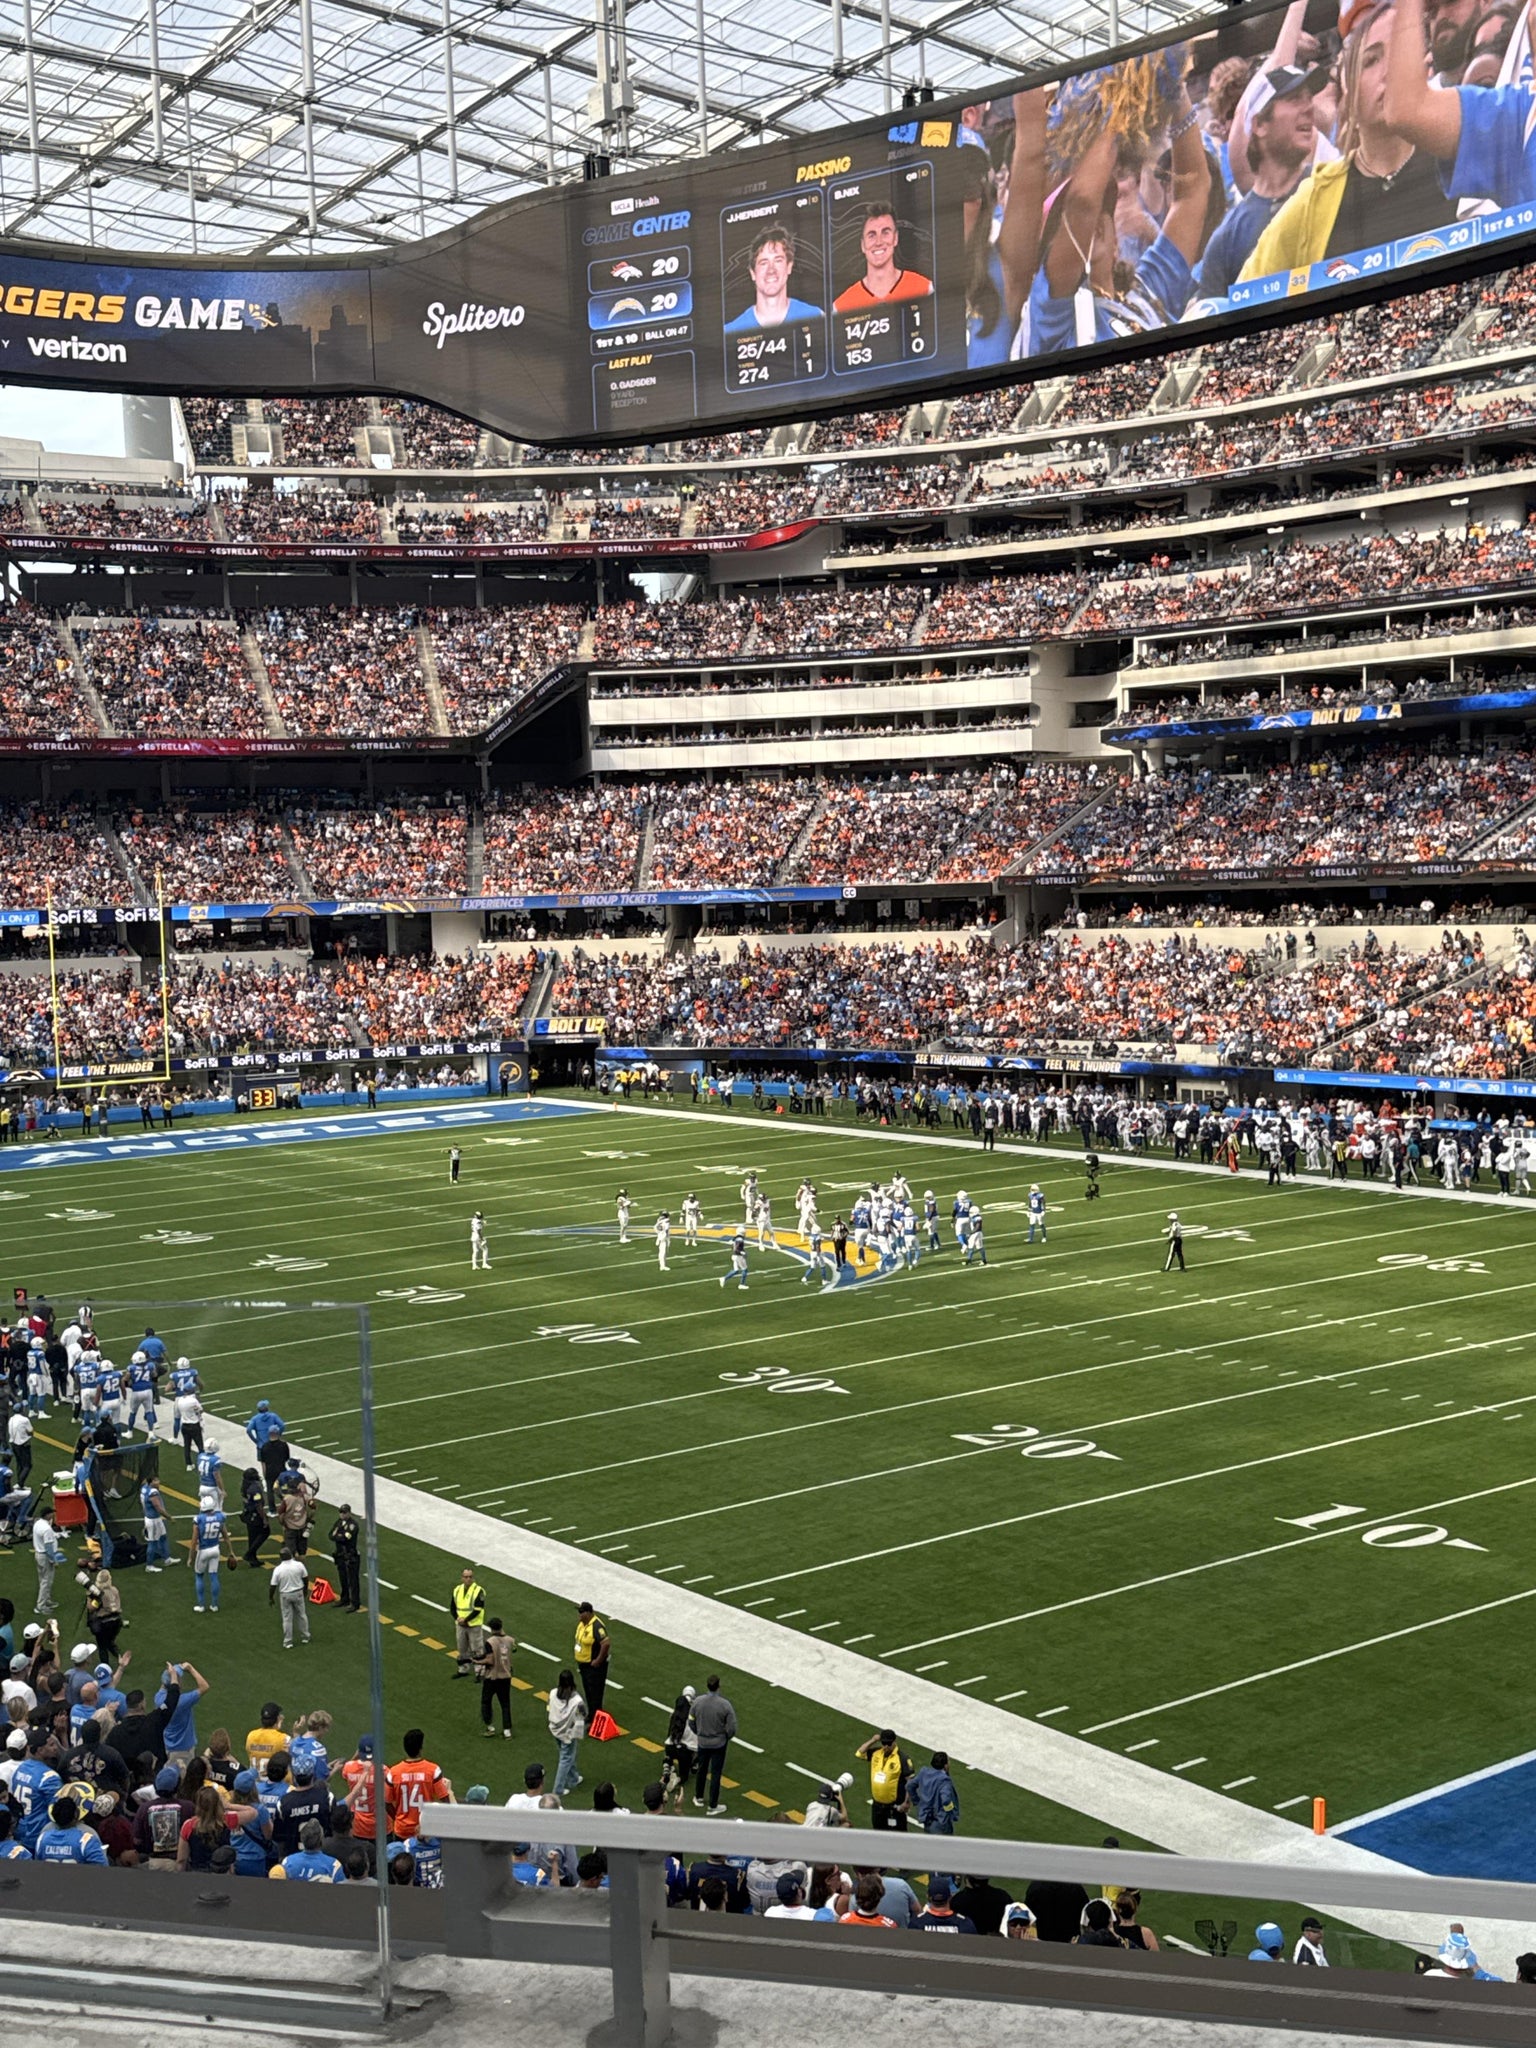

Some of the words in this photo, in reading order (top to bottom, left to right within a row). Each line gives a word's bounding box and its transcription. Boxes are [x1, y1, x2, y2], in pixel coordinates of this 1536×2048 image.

[795, 156, 852, 183] PASSING
[834, 186, 860, 200] B.NIX
[634, 195, 660, 209] Health
[726, 204, 780, 224] J.HERBERT
[581, 221, 632, 246] GAME
[632, 210, 691, 237] CENTER
[1482, 219, 1504, 236] 1ST
[1503, 215, 1516, 228] &
[1517, 209, 1534, 224] 10
[1448, 228, 1469, 246] 20
[651, 256, 680, 277] 20
[1362, 253, 1383, 270] 20
[1291, 274, 1307, 287] 33
[1231, 289, 1251, 303] Q4
[1262, 280, 1281, 295] 1:10
[0, 285, 127, 324] GERS
[134, 296, 246, 331] GAME
[650, 292, 678, 313] 20
[422, 301, 526, 350] Splitero
[913, 311, 921, 327] 1
[644, 329, 665, 340] BALL
[665, 328, 677, 337] ON
[677, 325, 688, 335] 47
[845, 317, 891, 341] 14/25
[596, 338, 614, 349] 1ST
[614, 335, 624, 346] &
[625, 333, 639, 345] 10
[804, 332, 812, 348] 1
[911, 337, 925, 354] 0
[27, 335, 128, 363] verizon
[737, 338, 788, 360] 25/44
[845, 348, 873, 366] 153
[608, 358, 630, 370] LAST
[630, 354, 653, 367] PLAY
[805, 358, 813, 373] 1
[619, 376, 657, 389] GADSDEN
[738, 366, 770, 385] 274
[1310, 709, 1342, 726] BOLT
[1343, 707, 1362, 723] UP
[582, 895, 619, 906] GROUP
[620, 893, 659, 905] TICKETS
[843, 890, 856, 898] CC
[462, 898, 525, 910] EXPERIENCES
[8, 915, 22, 924] ON
[23, 914, 36, 922] 47
[50, 910, 81, 925] SoFi
[114, 908, 147, 923] SoFi
[190, 908, 206, 917] 34
[547, 1018, 583, 1033] BOLT
[325, 1049, 349, 1061] SoFi
[373, 1047, 397, 1059] SoFi
[420, 1045, 444, 1056] SoFi
[466, 1043, 490, 1054] SoFi
[184, 1058, 208, 1070] SoFi
[231, 1055, 255, 1067] SoFi
[277, 1053, 301, 1064] SoFi
[914, 1053, 929, 1065] SEE
[929, 1054, 944, 1065] THE
[944, 1055, 987, 1067] LIGHTNING
[1045, 1059, 1064, 1071] FEEL
[1065, 1060, 1081, 1072] THE
[1082, 1061, 1121, 1073] THUNDER
[62, 1066, 85, 1078] FEEL
[87, 1064, 107, 1077] THE
[108, 1061, 154, 1076] THUNDER
[1276, 1072, 1288, 1082] Q4
[1438, 1080, 1452, 1090] 20
[1487, 1083, 1500, 1093] 20
[253, 1089, 274, 1107] 33
[20, 1111, 496, 1166] ANGELES
[139, 1230, 214, 1245] 30
[249, 1255, 329, 1272] 40
[16, 1289, 25, 1301] 2
[376, 1285, 467, 1304] 50
[530, 1322, 631, 1344] 40
[134, 1369, 150, 1383] 74
[718, 1366, 835, 1394] 30
[103, 1377, 120, 1393] 42
[950, 1424, 1097, 1459] 20
[198, 1460, 210, 1477] 41
[203, 1521, 220, 1539] 16
[1273, 1502, 1449, 1549] 10
[311, 1581, 326, 1601] 20
[591, 1713, 607, 1738] 10
[400, 1772, 425, 1782] SUTTON
[400, 1783, 424, 1813] 14
[290, 1806, 311, 1817] JAMES
[310, 1804, 320, 1814] JR
[45, 1845, 73, 1856] CALDWELL
